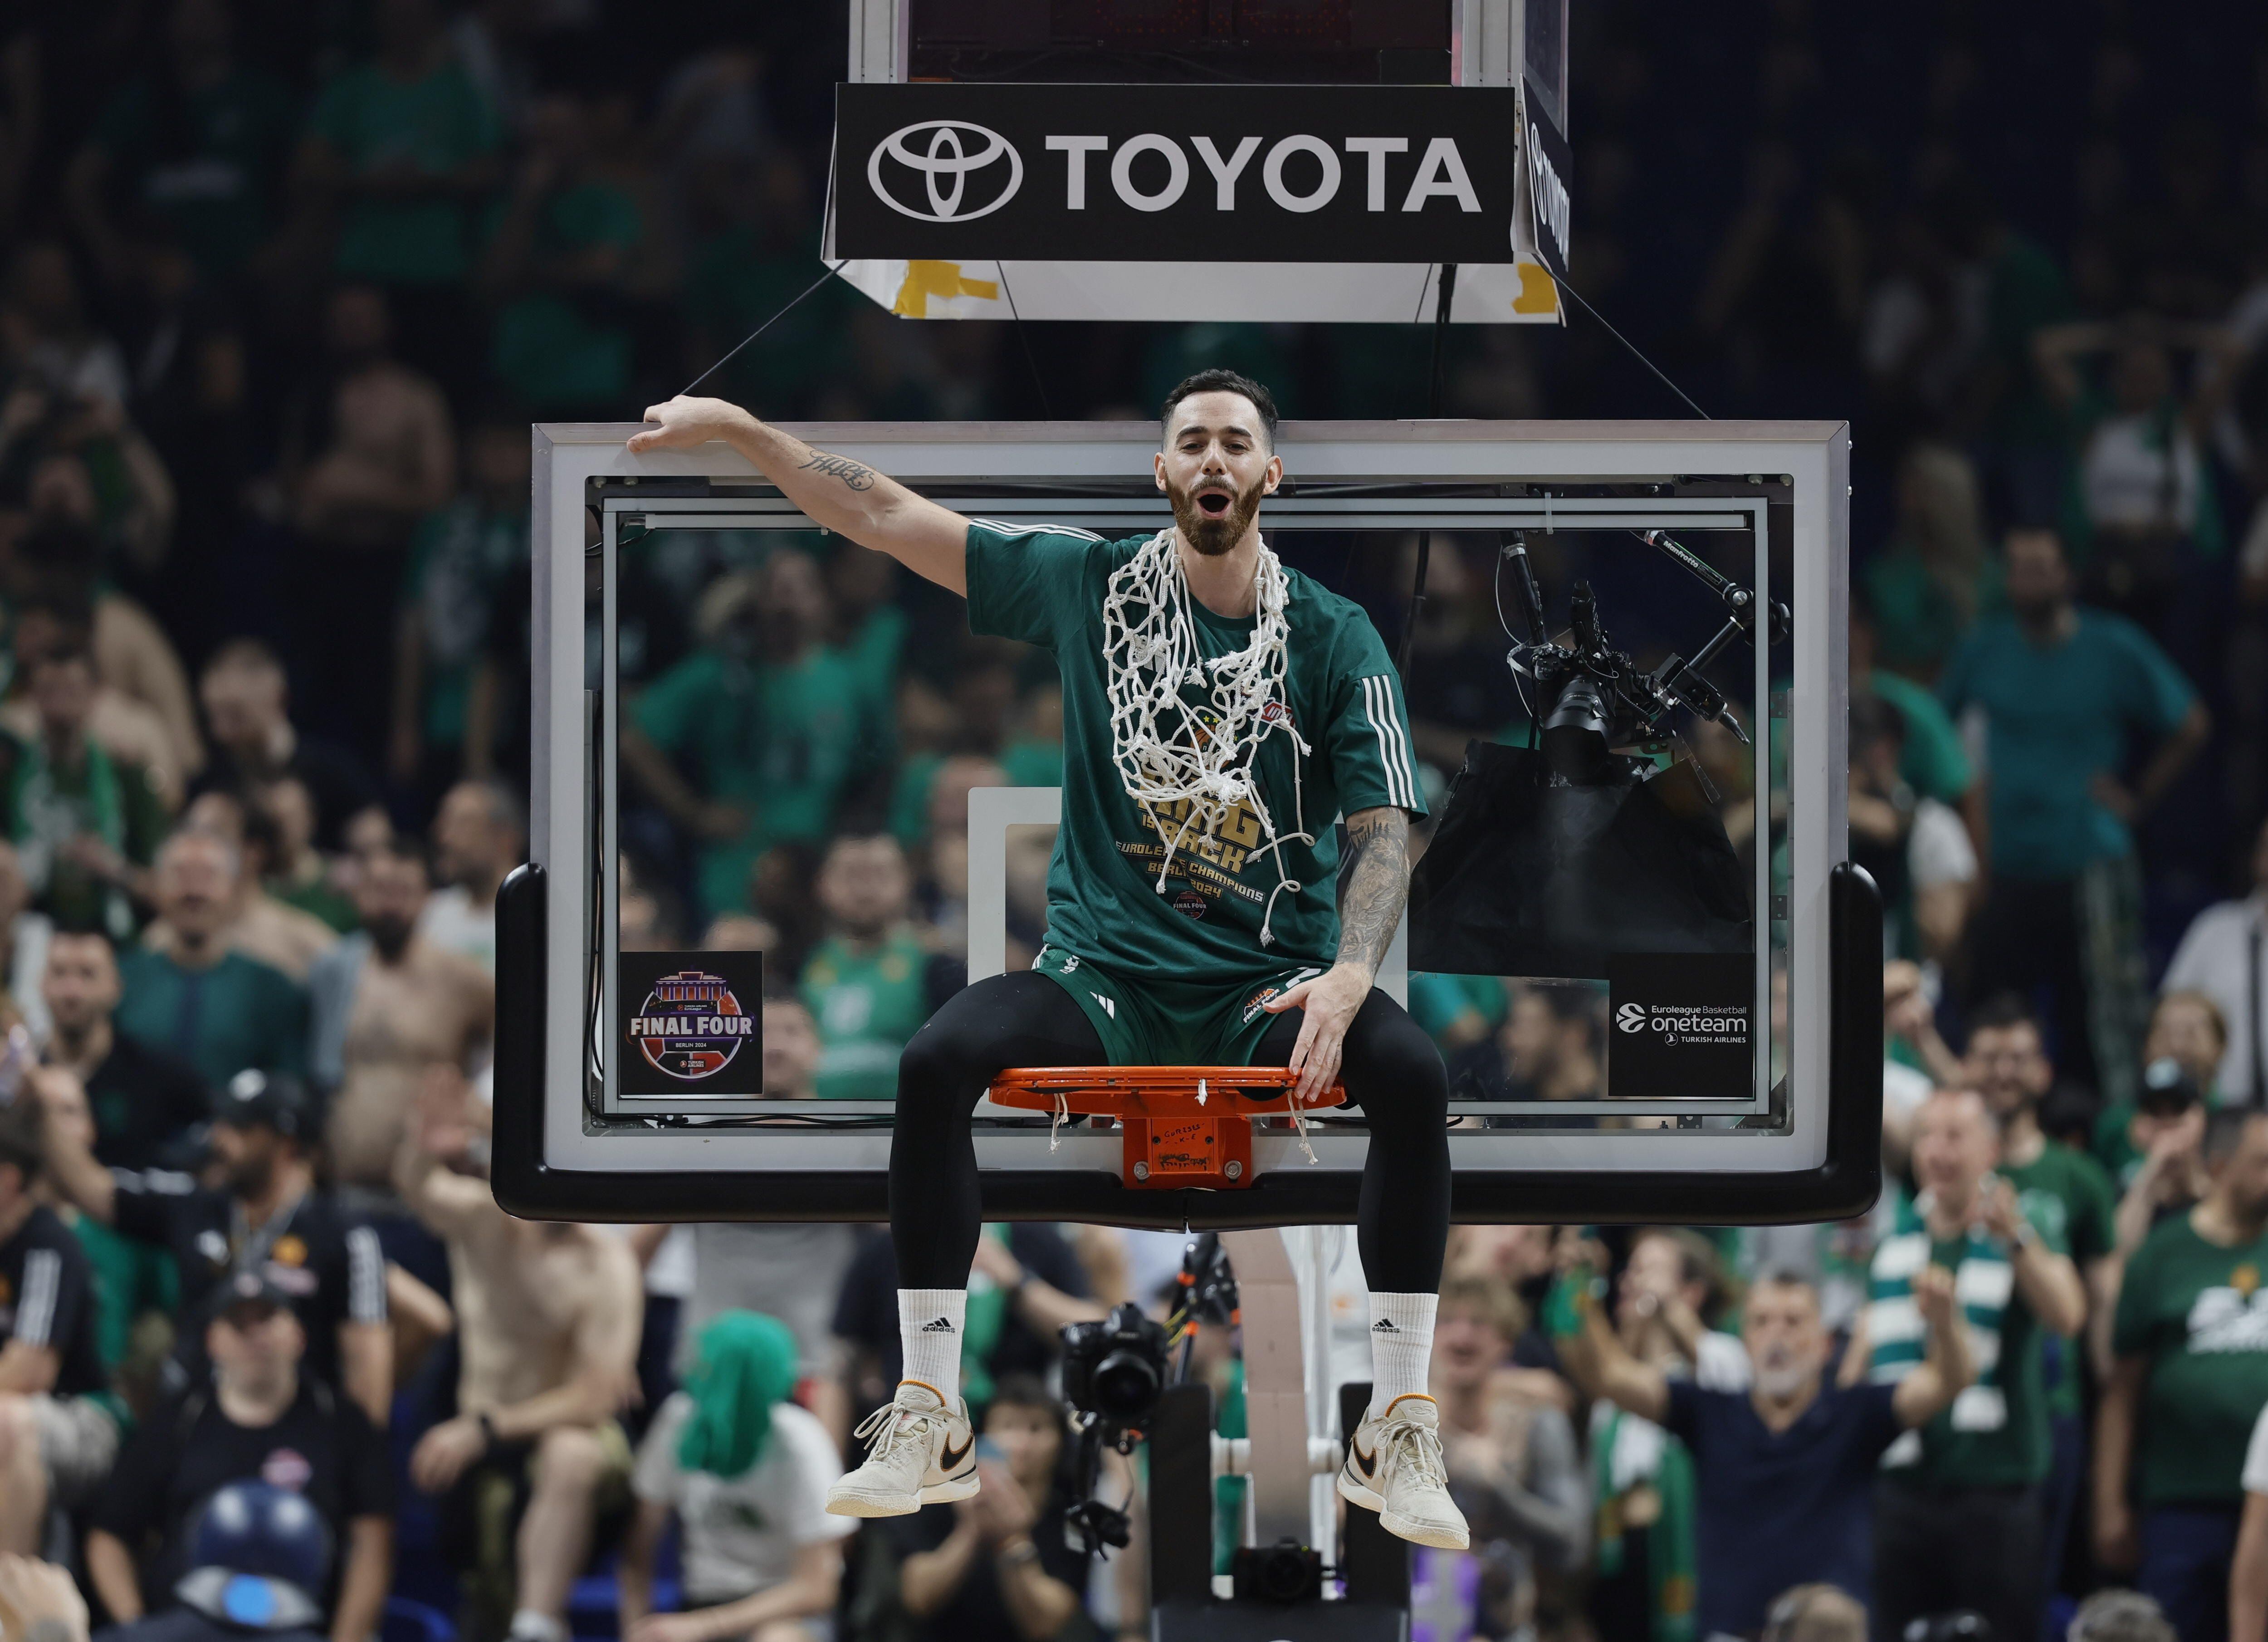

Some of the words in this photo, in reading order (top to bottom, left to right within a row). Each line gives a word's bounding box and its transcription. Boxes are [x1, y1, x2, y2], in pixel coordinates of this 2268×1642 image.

[1046, 133, 1482, 213] TOYOTA
[1663, 541, 1698, 568] Manfrotto
[1159, 818, 1246, 874] BACK
[1188, 862, 1264, 903] CHAMPIONS
[1243, 1003, 1262, 1023] FINAL
[1261, 988, 1280, 1005] FOUR
[1652, 1005, 1701, 1015] Euroleague
[1702, 1005, 1747, 1014] Basketball
[631, 1017, 692, 1035] FINAL
[697, 1016, 752, 1034] FOUR
[1652, 1014, 1746, 1032] oneteam
